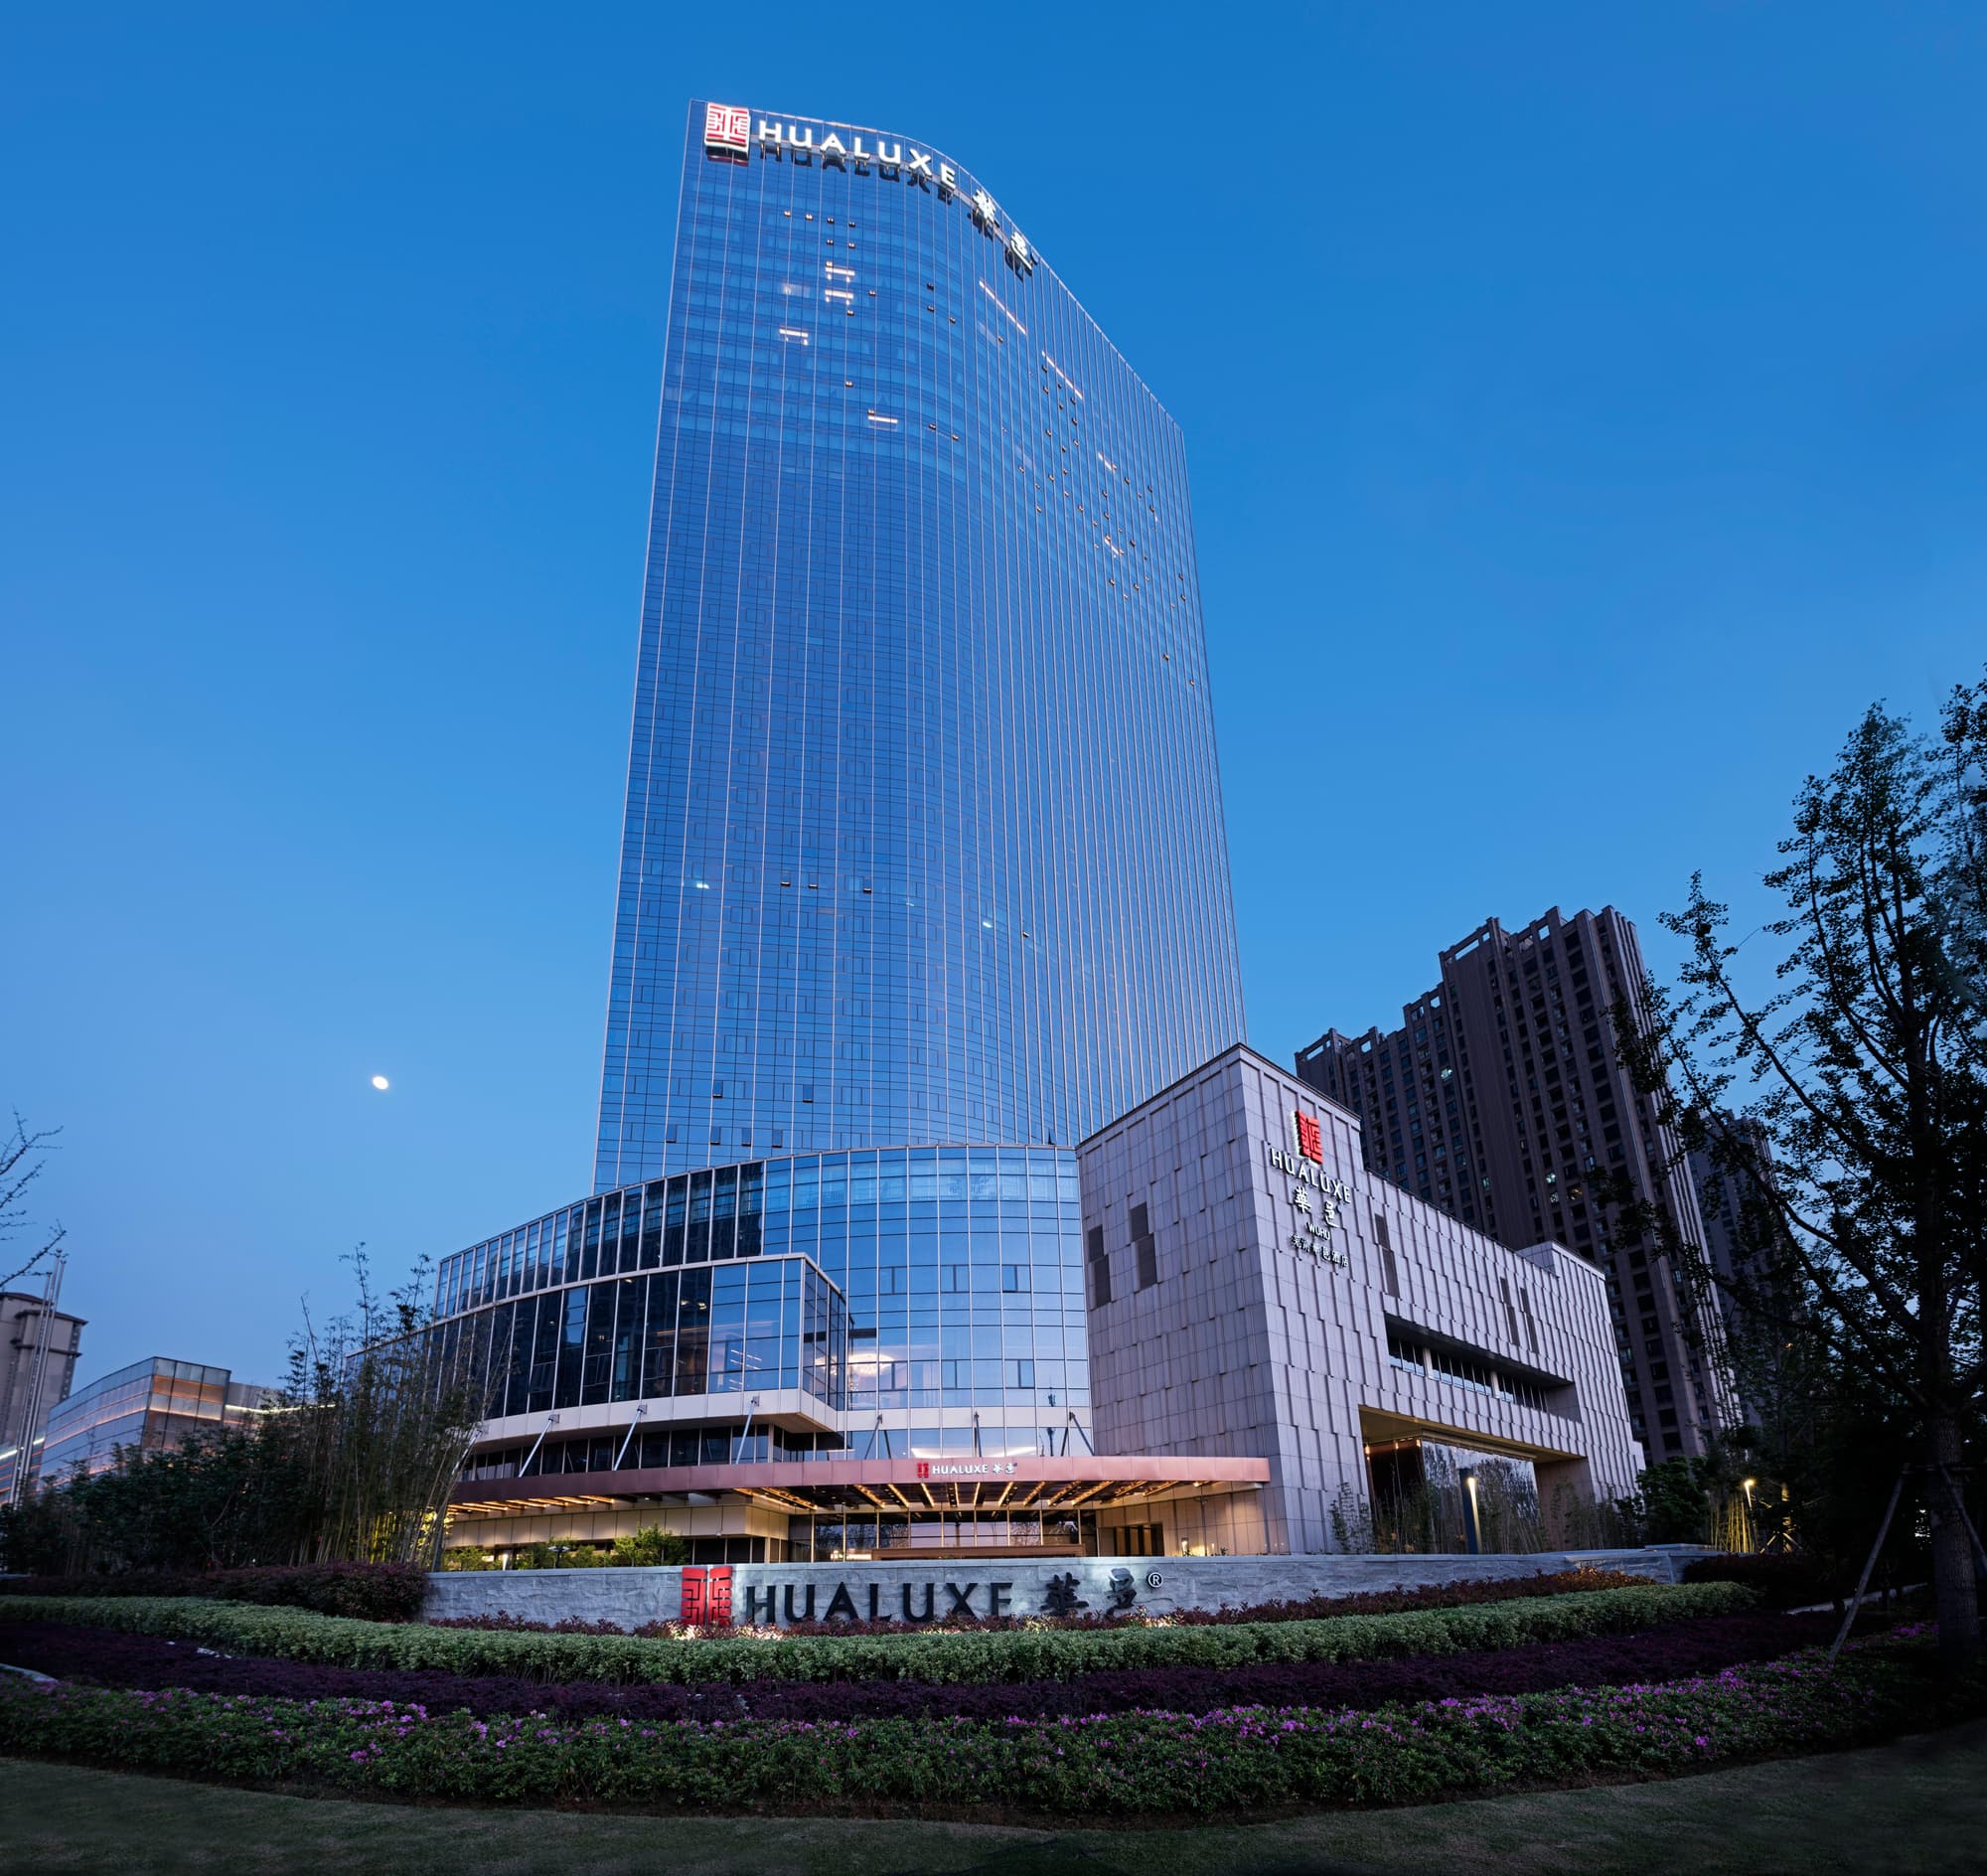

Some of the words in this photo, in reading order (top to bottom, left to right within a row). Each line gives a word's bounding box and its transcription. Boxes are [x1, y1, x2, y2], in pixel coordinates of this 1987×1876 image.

[758, 119, 957, 191] HUALUXE
[1270, 1147, 1352, 1204] HUALUXE
[933, 1464, 989, 1475] HUALUXE
[746, 1581, 1013, 1623] HUALUXE
